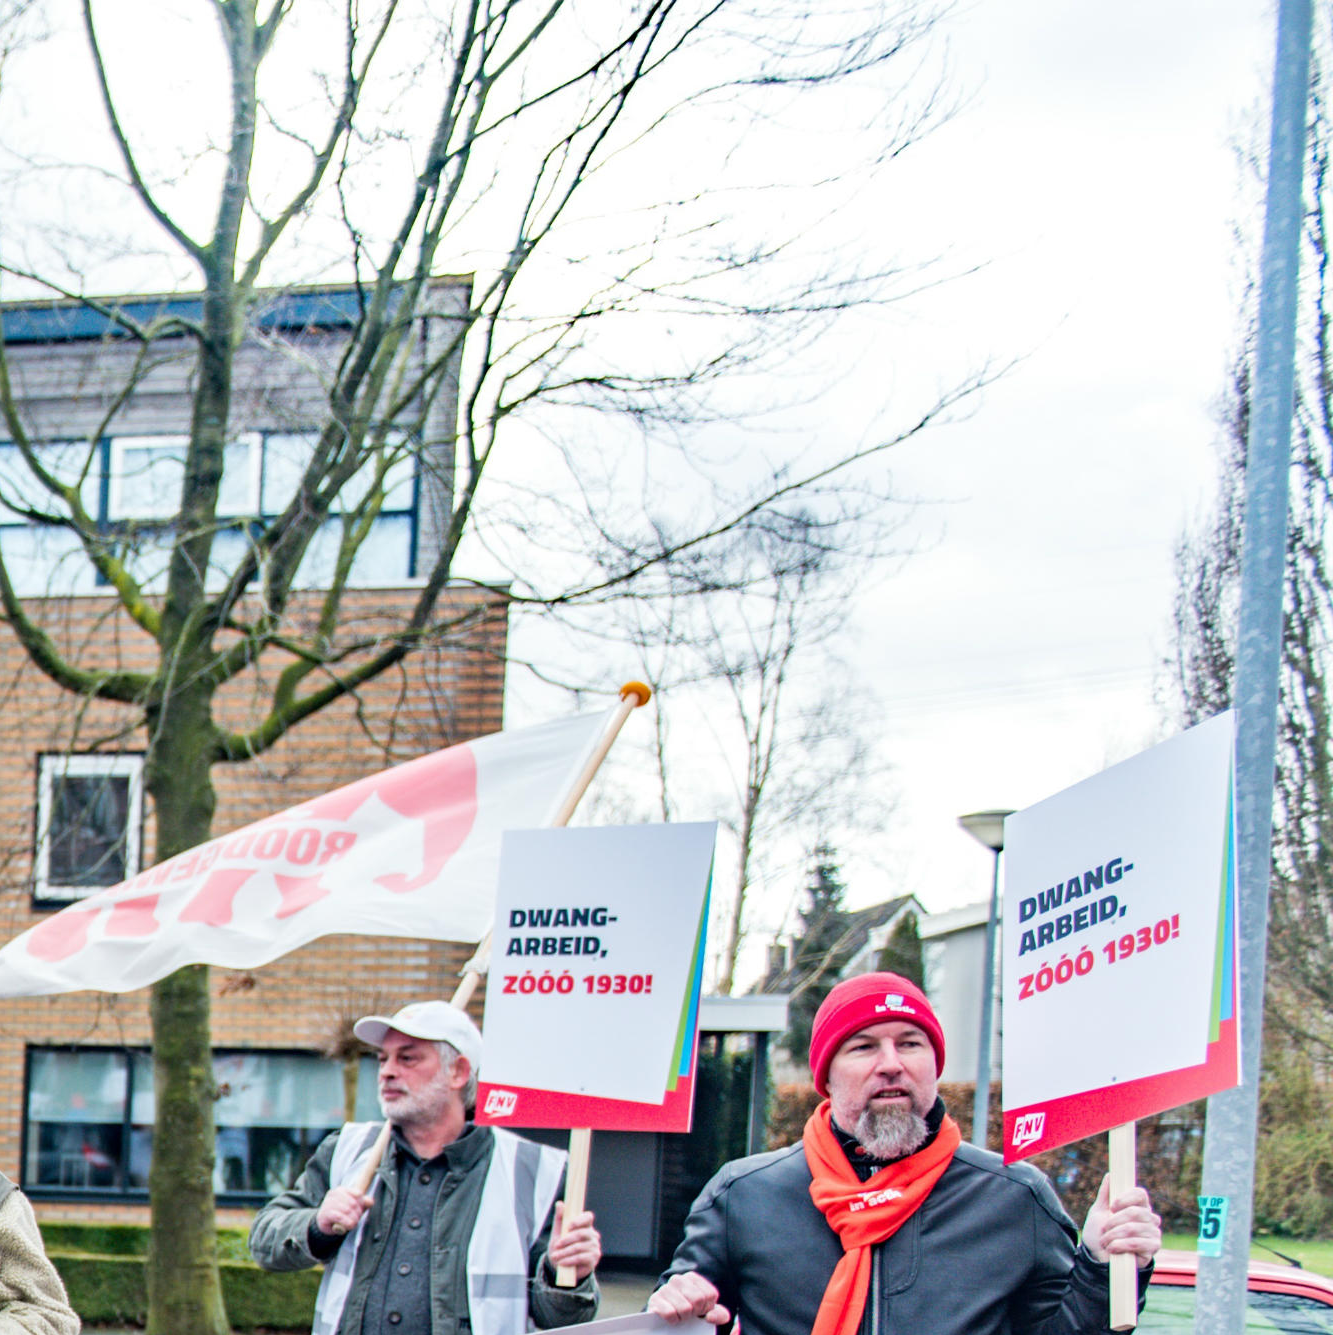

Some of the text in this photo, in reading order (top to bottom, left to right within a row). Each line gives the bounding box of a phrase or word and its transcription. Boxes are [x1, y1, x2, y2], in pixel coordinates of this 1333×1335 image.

[1019, 856, 1134, 924] DWANG-
[509, 907, 618, 928] DWANG-
[1018, 895, 1127, 957] ARBEID,
[506, 936, 608, 958] ARBEID,
[1018, 913, 1180, 1001] ZÓÓÓ 1930!
[502, 969, 653, 994] ZÓÓÓ 1930!
[1014, 1115, 1043, 1141] FNV
[1198, 1207, 1221, 1239] 5
